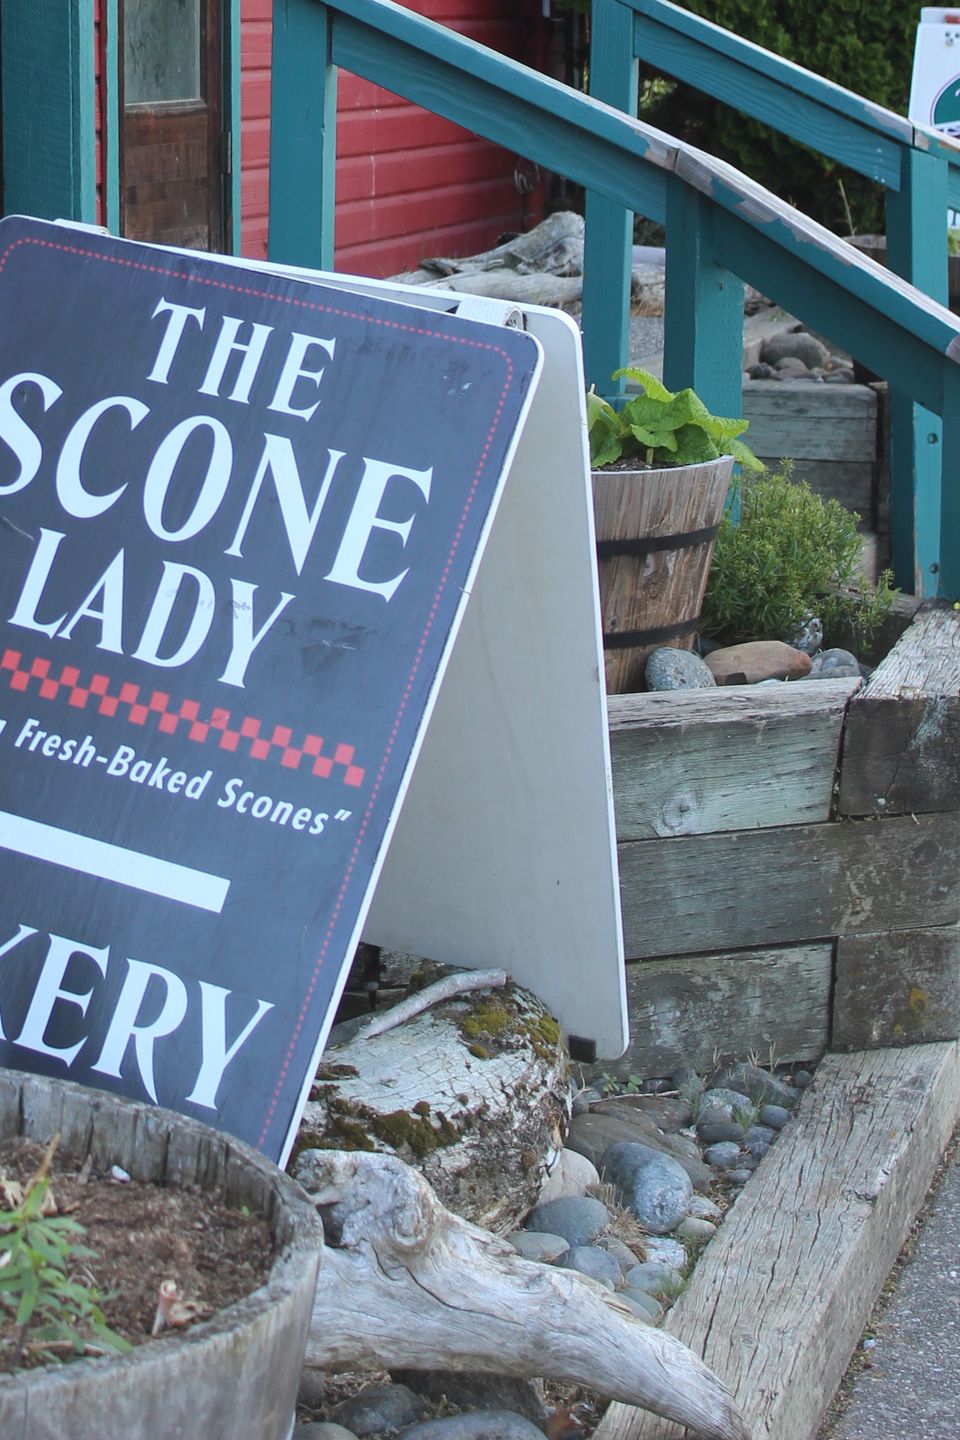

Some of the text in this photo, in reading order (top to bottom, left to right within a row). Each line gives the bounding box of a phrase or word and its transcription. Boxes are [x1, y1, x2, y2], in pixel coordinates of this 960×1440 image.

[146, 297, 336, 423] THE
[7, 526, 297, 689] LADY
[14, 717, 213, 801] Fresh-Baked
